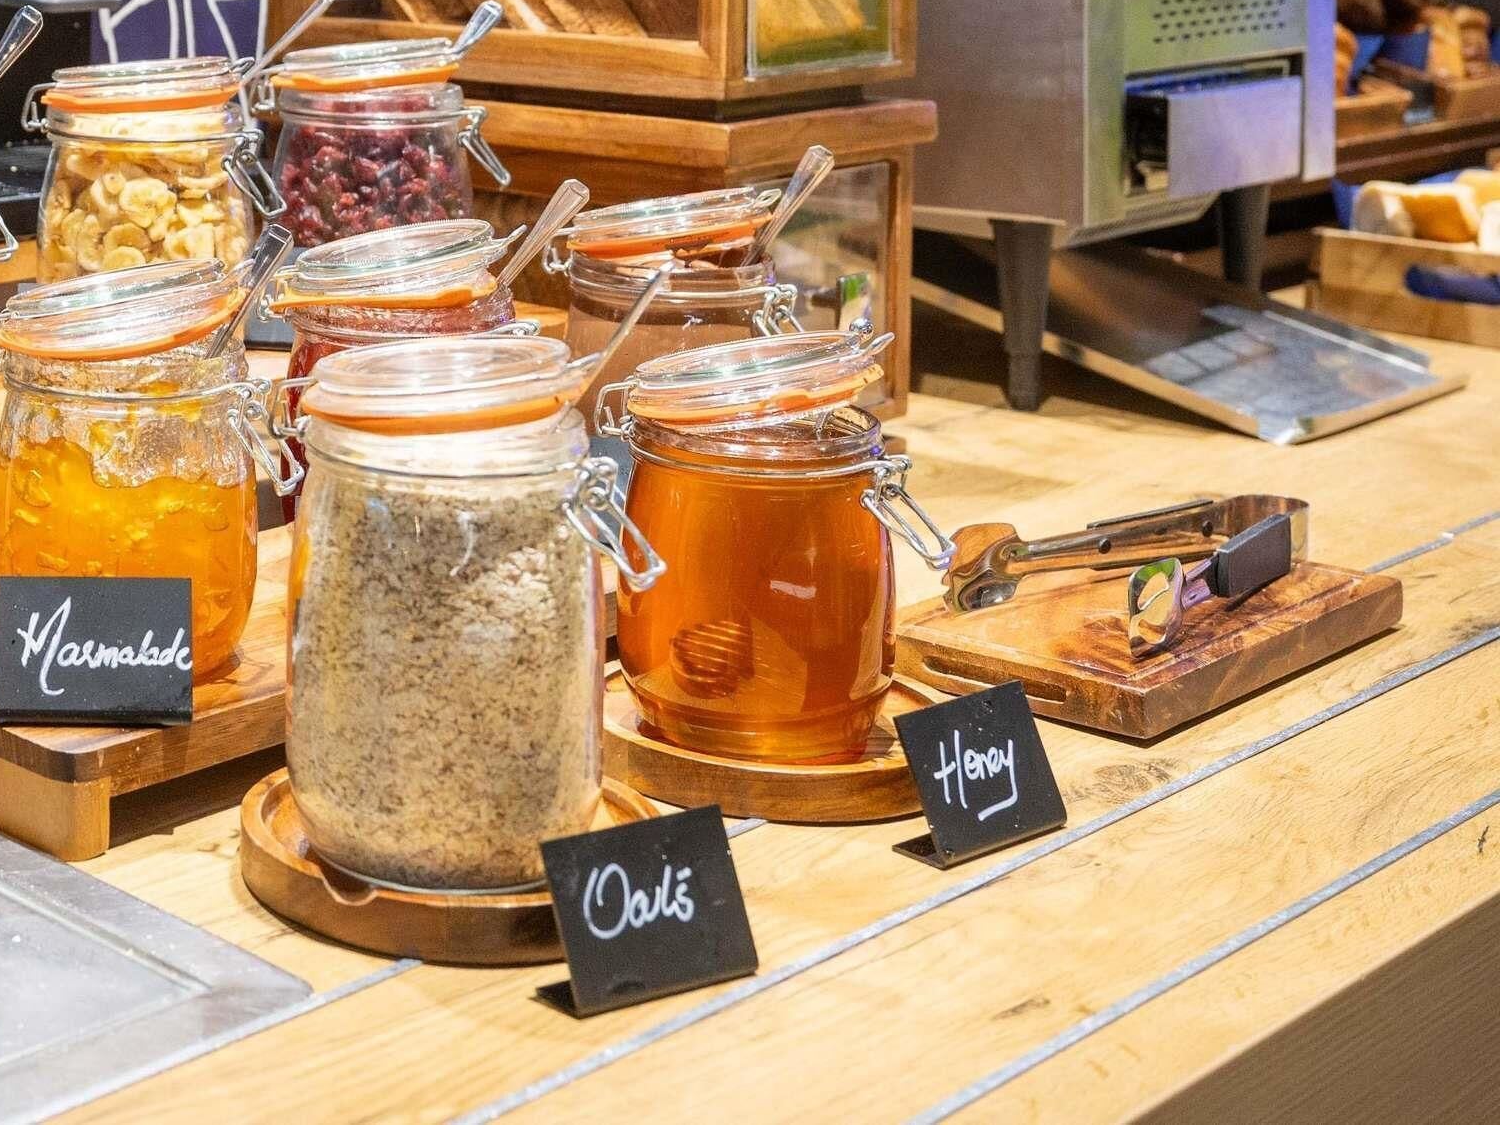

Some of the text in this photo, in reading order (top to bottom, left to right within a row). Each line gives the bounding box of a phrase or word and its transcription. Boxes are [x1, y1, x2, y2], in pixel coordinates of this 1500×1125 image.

[16, 595, 194, 697] Marmalade
[933, 728, 1019, 822] Honey
[582, 861, 695, 940] Oats
